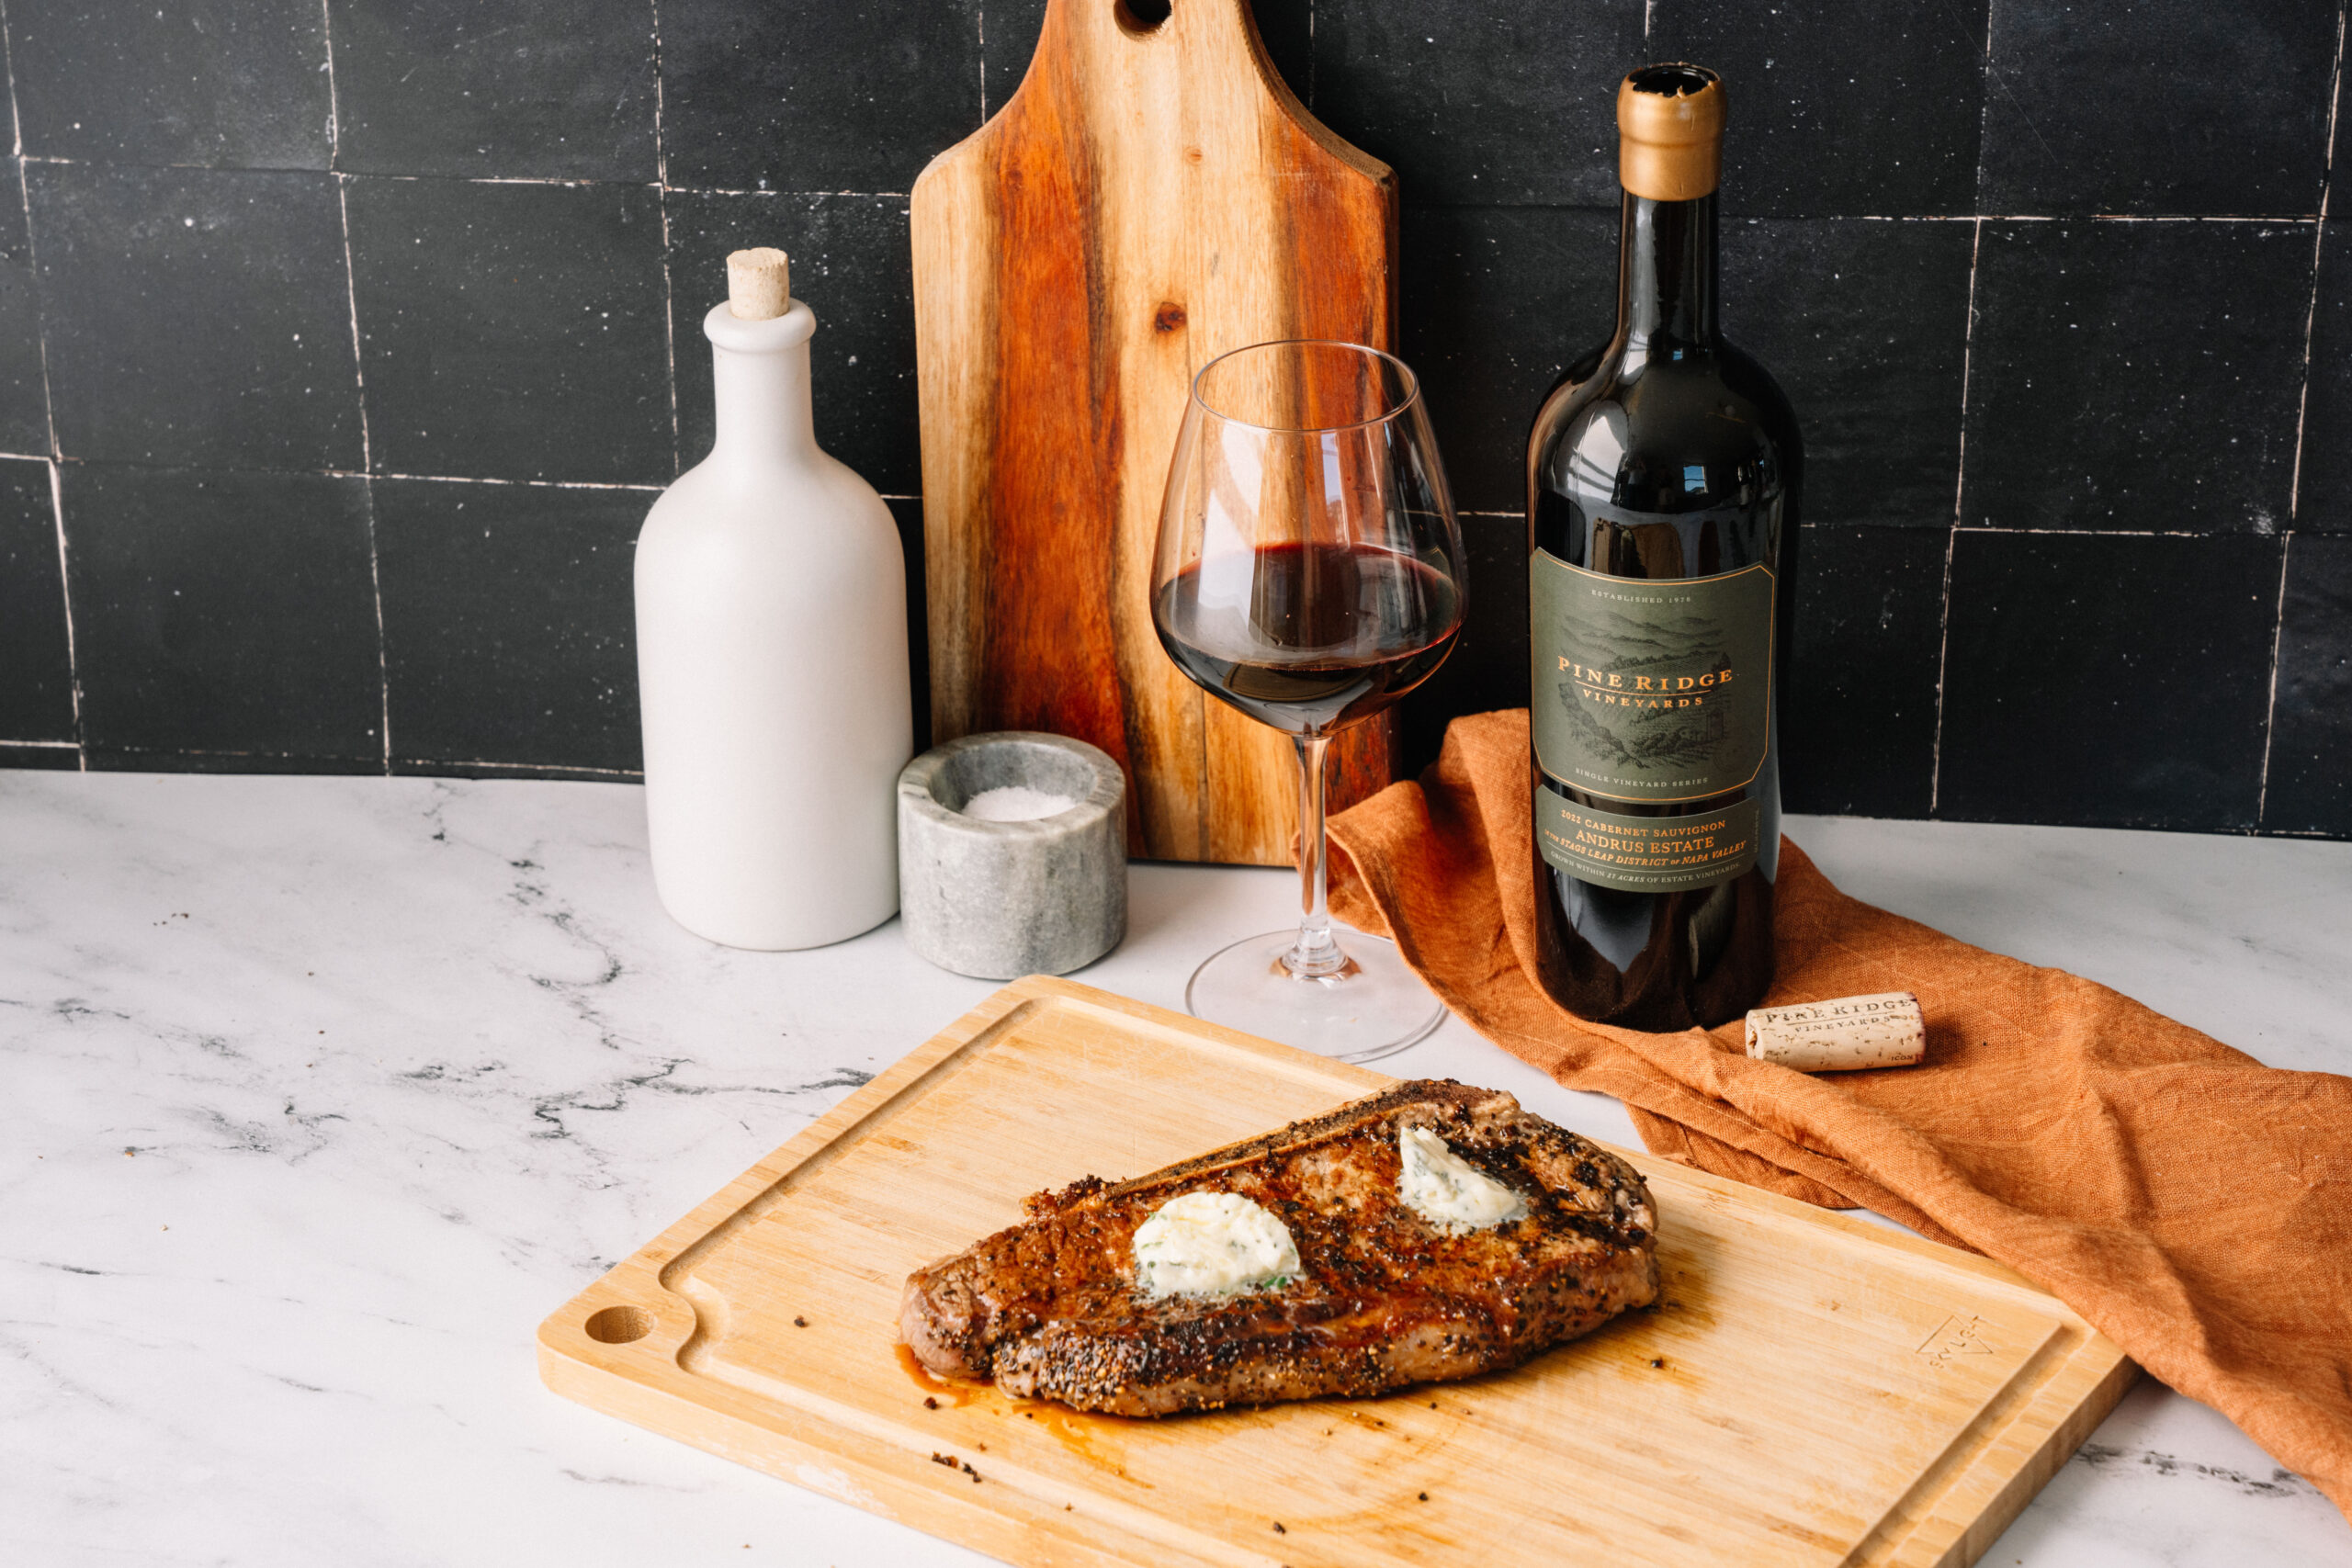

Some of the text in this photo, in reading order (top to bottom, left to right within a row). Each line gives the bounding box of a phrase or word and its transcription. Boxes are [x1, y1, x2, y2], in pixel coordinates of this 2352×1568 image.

[1591, 589, 1663, 604] ESTABLISHED
[1557, 655, 1734, 691] PINE RIDGE
[1582, 689, 1703, 708] VINEYARDS
[1575, 767, 1709, 788] SINGLE VINEYARD SERIES
[1561, 809, 1726, 838] 2022 CABERNET SAUVIGNON
[1560, 837, 1587, 854] STAGS
[1588, 848, 1614, 862] LEAP
[1615, 854, 1668, 867] DISTRICT
[1681, 854, 1709, 865] NAPA
[1712, 840, 1747, 859] VALLEY
[1575, 829, 1715, 854] ANDRUS ESTATE
[1550, 850, 1575, 867] GROWN
[1577, 862, 1605, 877] WITHIN
[1617, 874, 1645, 883] ACRES
[1660, 874, 1695, 884] ESTATE
[1766, 998, 1912, 1023] PINE RIDGE
[1794, 1015, 1891, 1032] VINEYARDS
